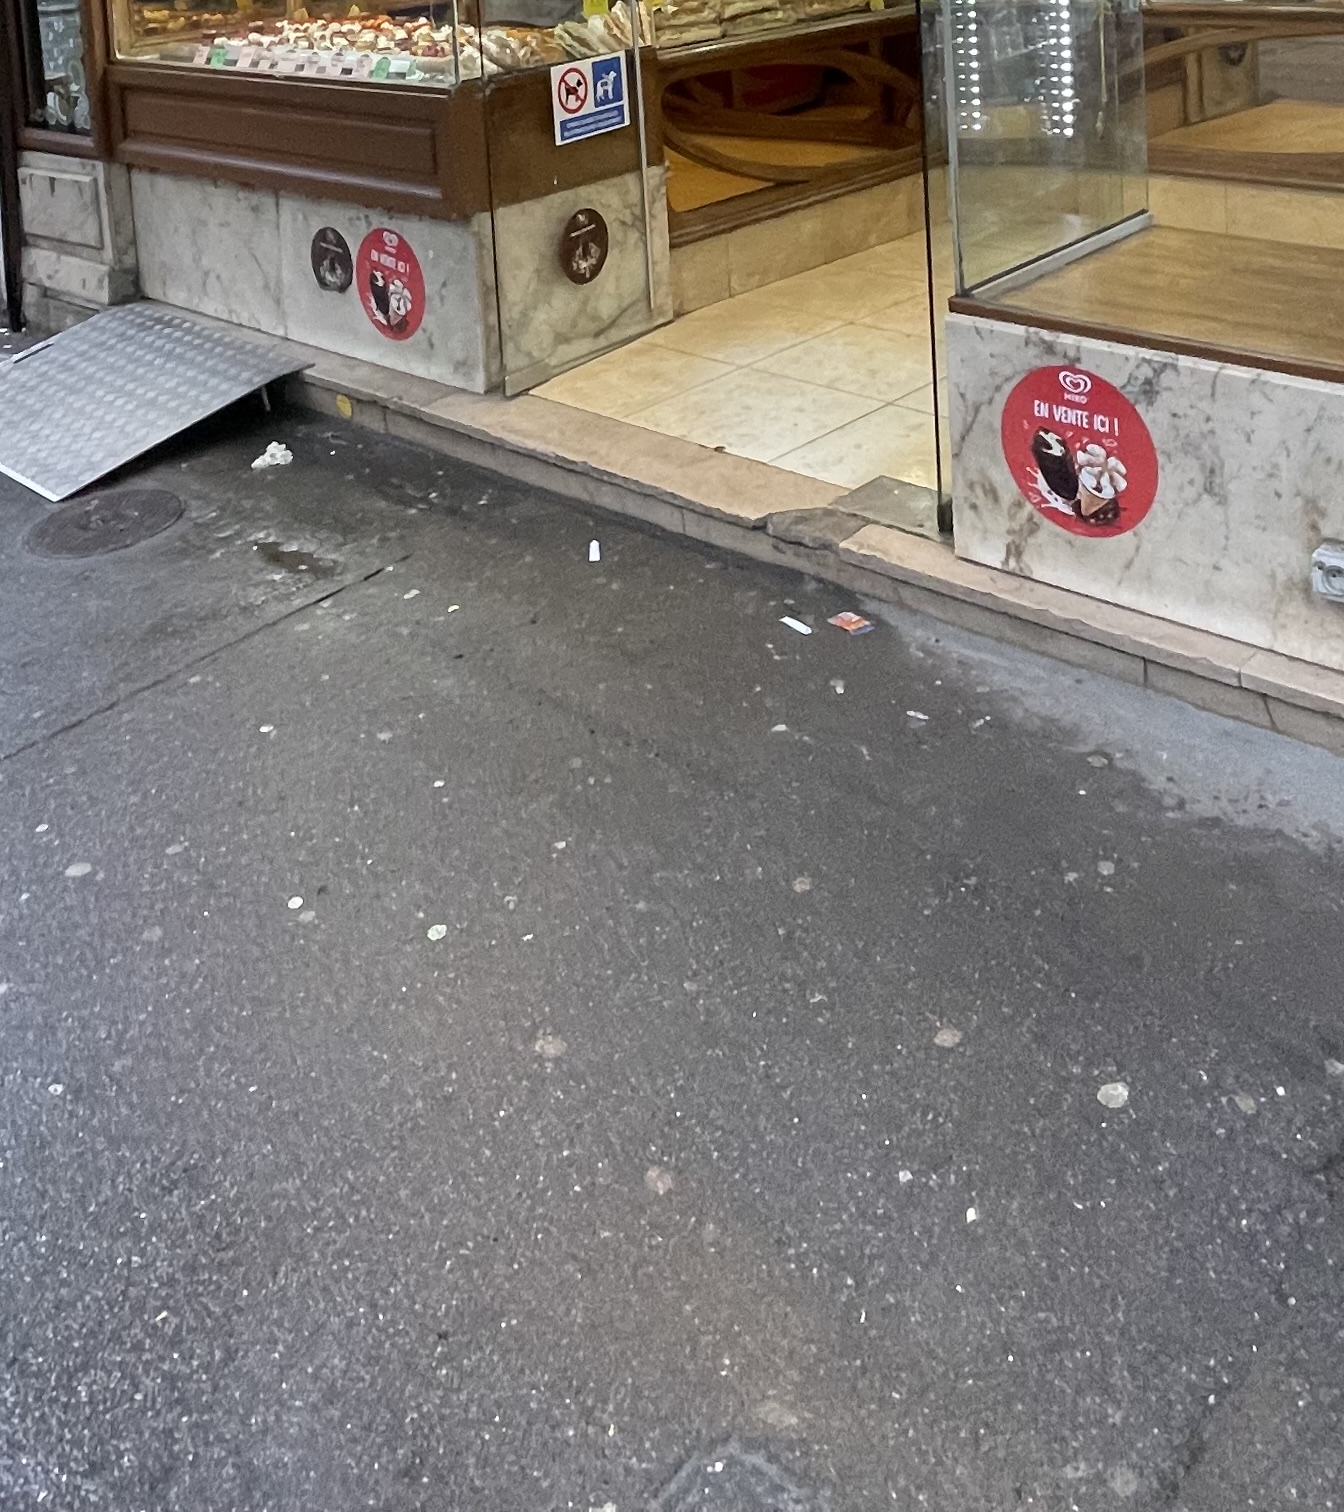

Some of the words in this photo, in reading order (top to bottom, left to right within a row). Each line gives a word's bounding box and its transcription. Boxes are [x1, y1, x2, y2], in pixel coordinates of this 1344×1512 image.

[1034, 400, 1049, 418] EN
[1053, 405, 1089, 429] VENTE
[1093, 414, 1110, 433] ICI
